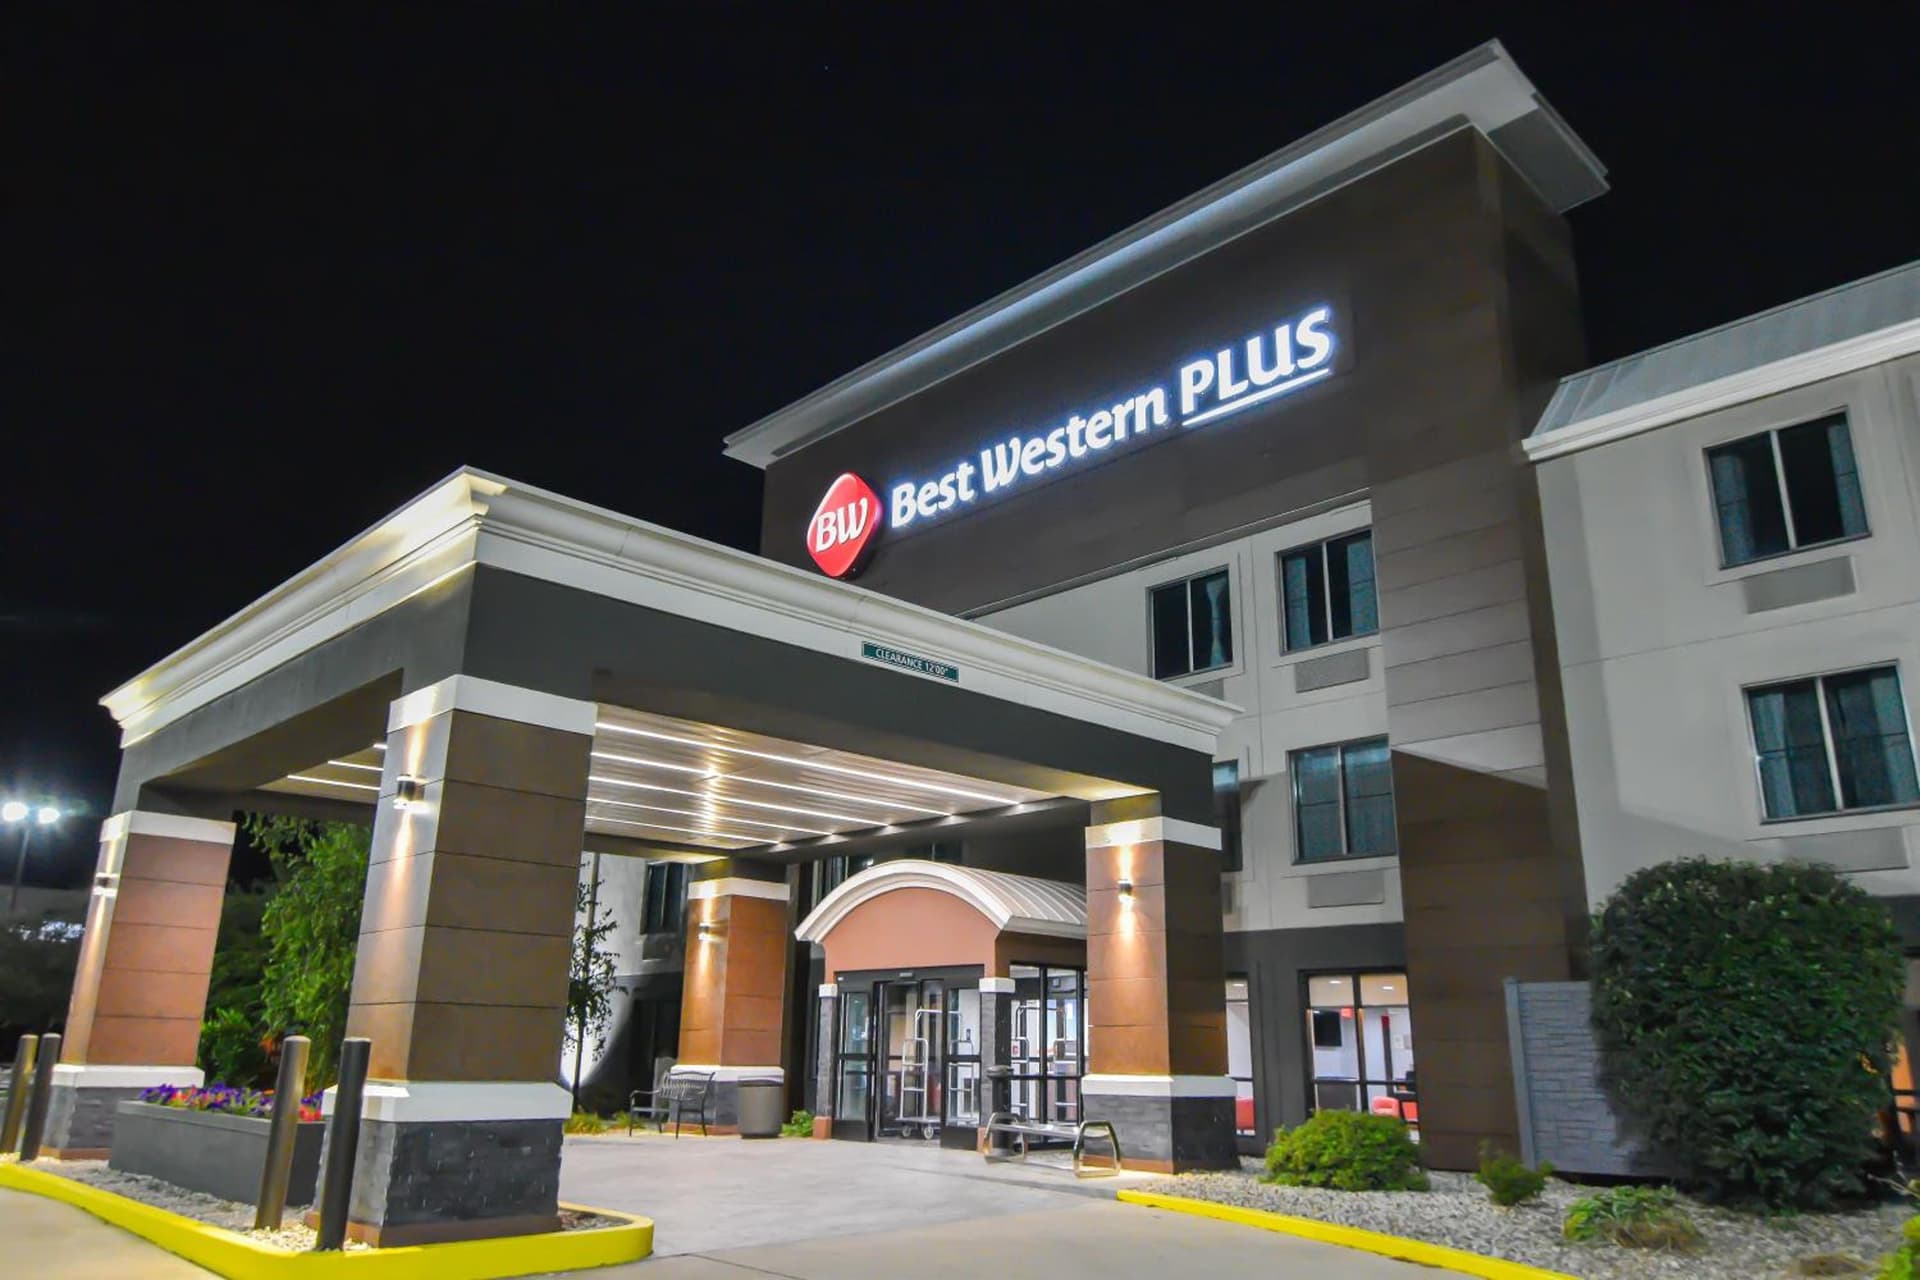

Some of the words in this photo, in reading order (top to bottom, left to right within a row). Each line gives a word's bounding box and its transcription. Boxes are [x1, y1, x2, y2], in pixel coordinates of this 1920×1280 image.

[891, 463, 975, 528] Best
[980, 387, 1168, 492] Western
[1180, 309, 1331, 415] PLUS
[815, 497, 868, 552] BW
[875, 648, 922, 670] CLEARANCE
